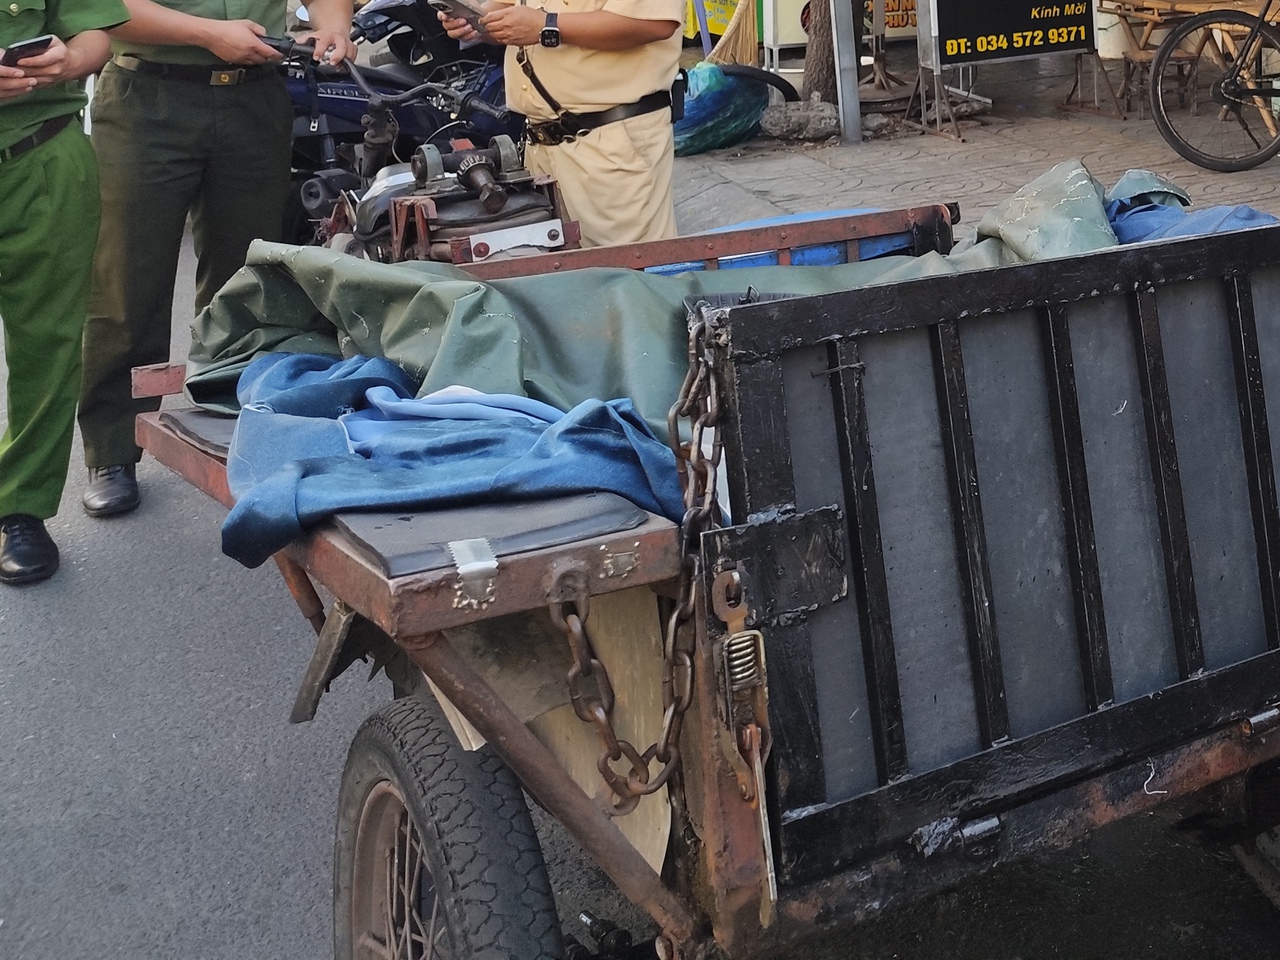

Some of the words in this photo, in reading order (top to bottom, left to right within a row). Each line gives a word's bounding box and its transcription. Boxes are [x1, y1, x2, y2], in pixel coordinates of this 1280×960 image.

[1030, 4, 1061, 20] Kính
[1064, 2, 1087, 16] Mời
[946, 38, 972, 55] ĐT:
[976, 34, 1009, 53] 034
[1013, 30, 1044, 48] 572
[1047, 25, 1086, 45] 9371
